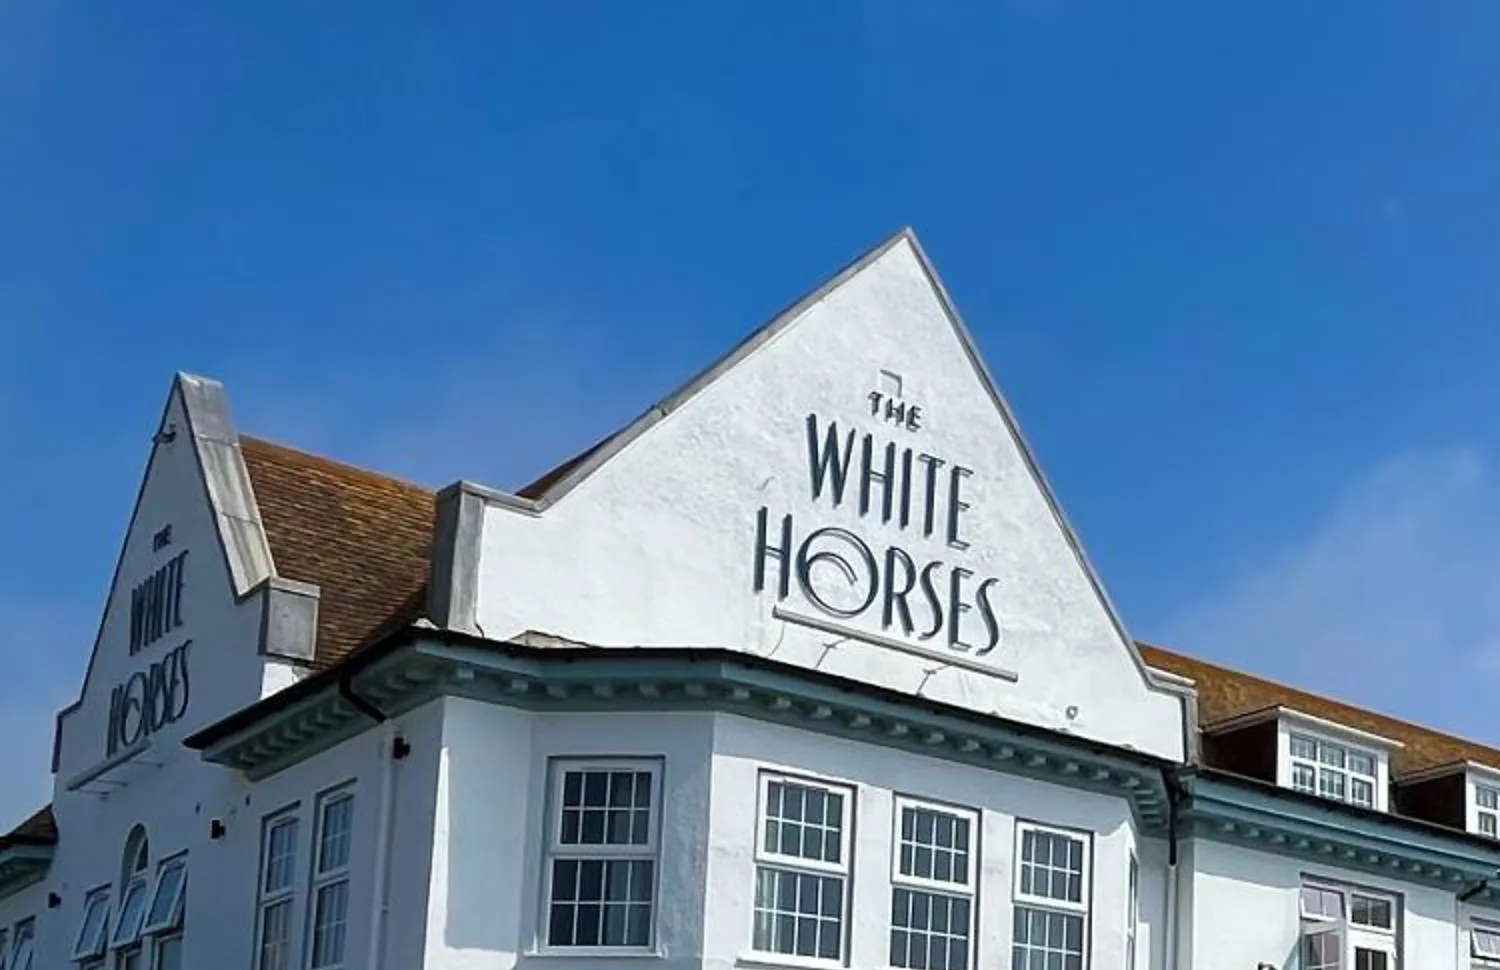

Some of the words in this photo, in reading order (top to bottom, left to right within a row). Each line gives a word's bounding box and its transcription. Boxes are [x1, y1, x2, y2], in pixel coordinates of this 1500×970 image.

[868, 391, 921, 432] THE
[805, 413, 975, 551] WHITE
[129, 549, 190, 656] WHITE
[753, 506, 1001, 656] HORSES
[106, 639, 192, 760] HORSES
